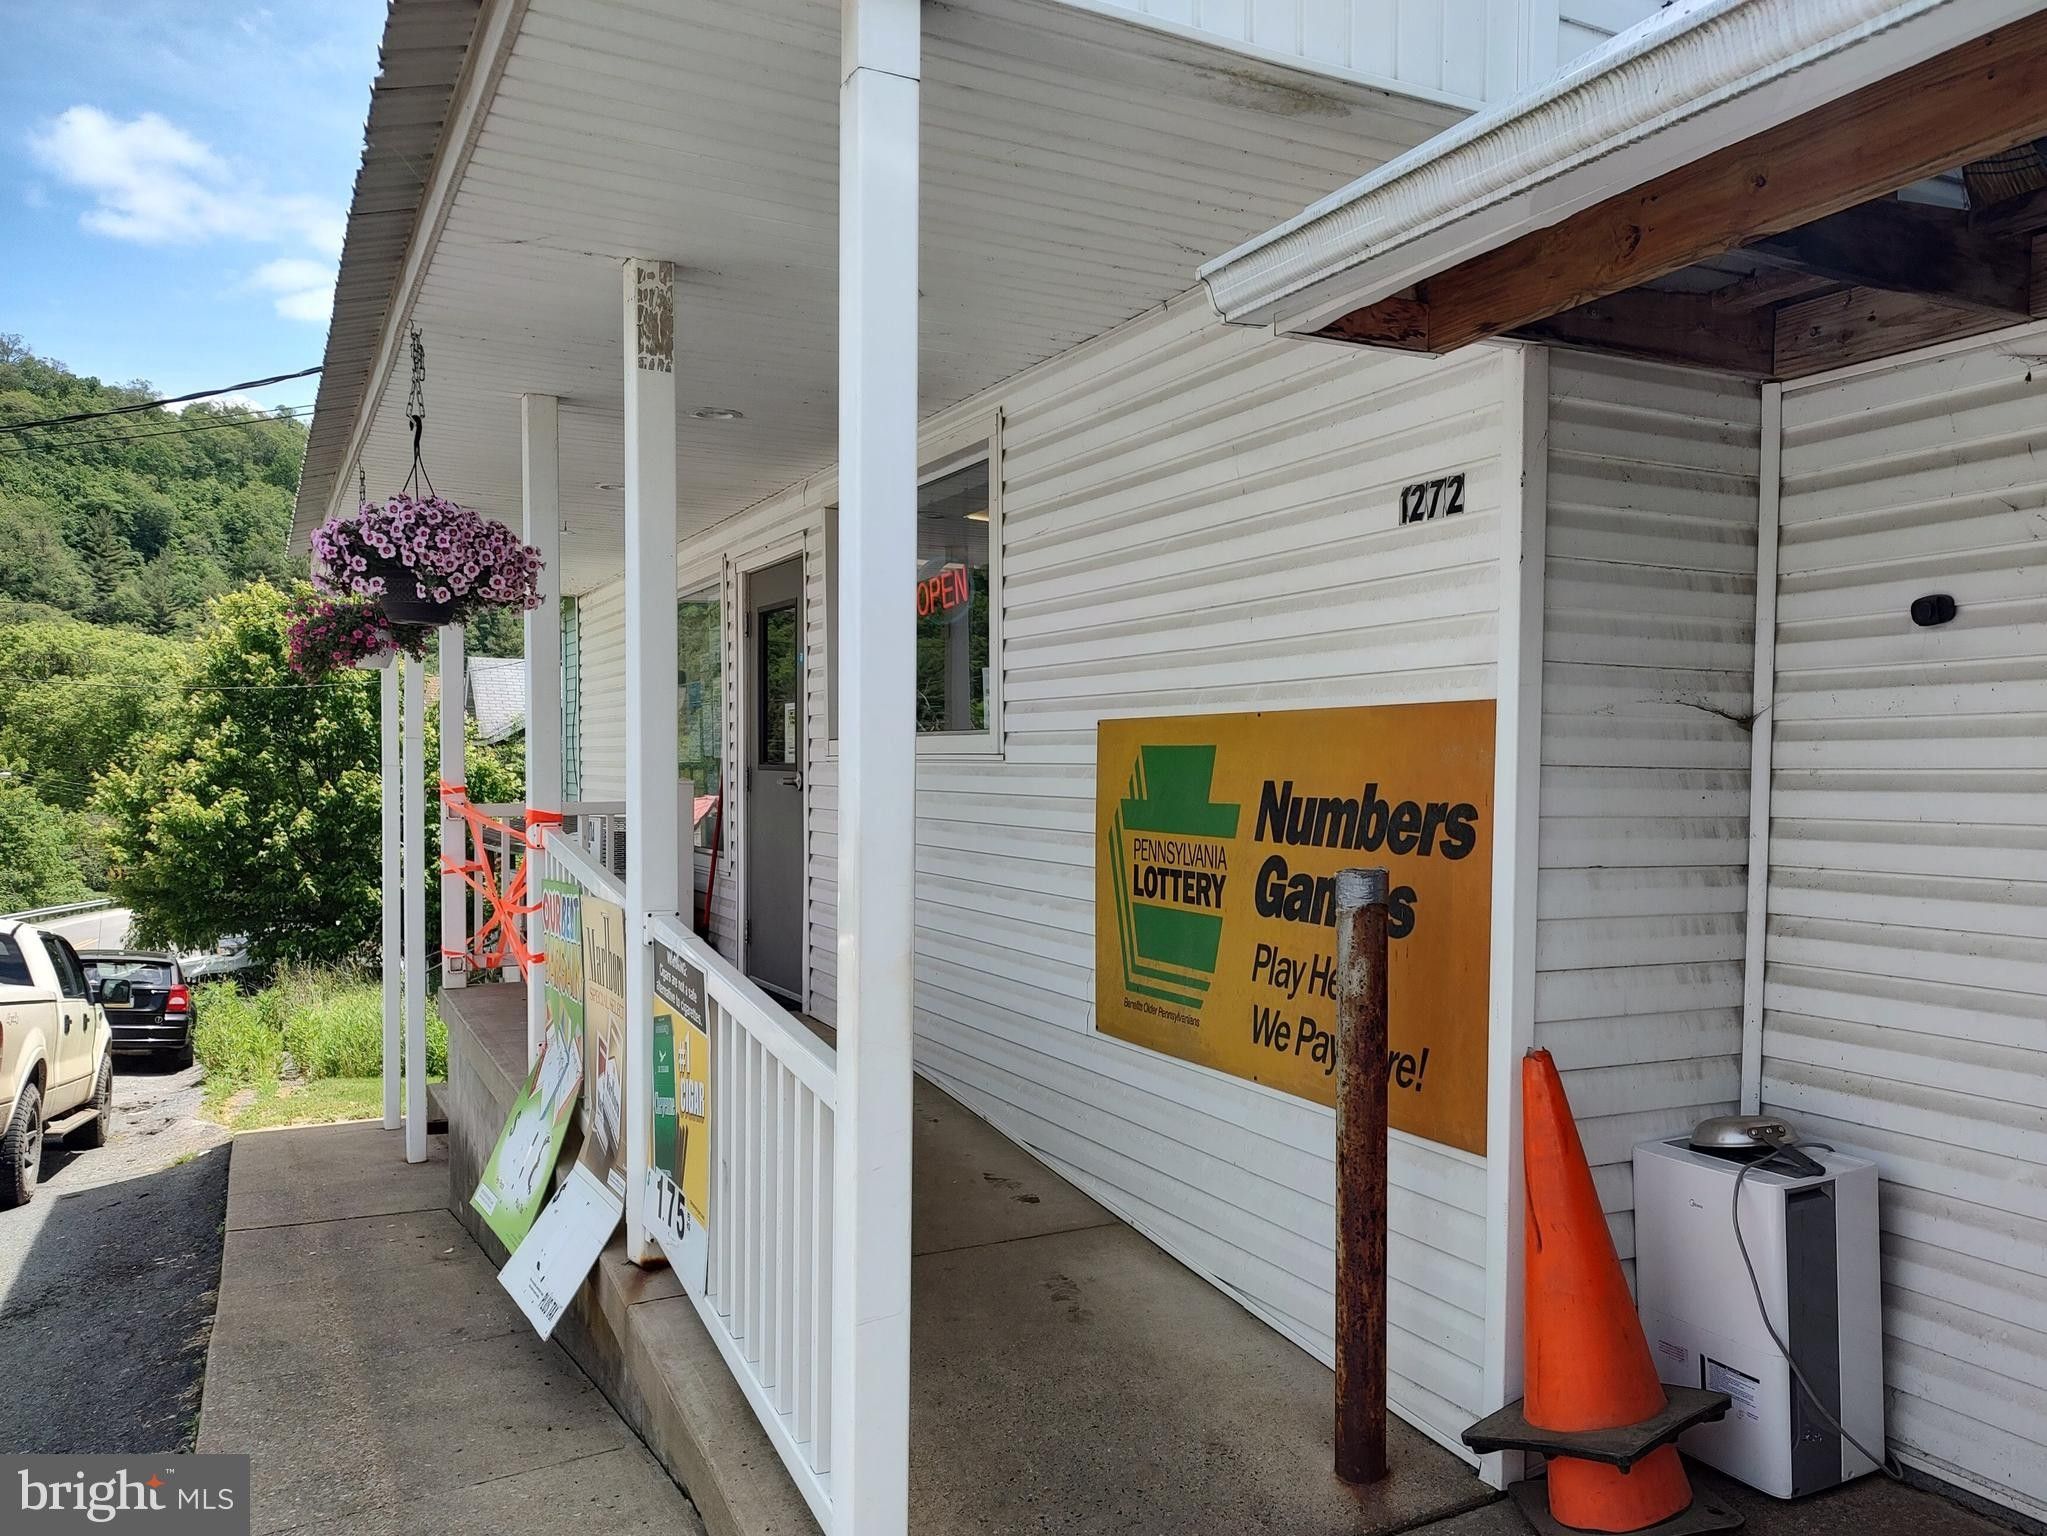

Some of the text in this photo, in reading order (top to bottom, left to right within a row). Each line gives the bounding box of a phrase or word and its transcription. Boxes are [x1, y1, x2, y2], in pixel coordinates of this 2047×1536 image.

[1399, 473, 1465, 525] 1272
[917, 565, 968, 616] OPEN
[1254, 780, 1479, 860] Numbers
[1134, 838, 1227, 871] PENNSYLVANIA
[1134, 864, 1227, 909] LOTTERY
[1255, 855, 1418, 939] Gams
[542, 890, 561, 937] OUR
[586, 911, 624, 999] Marlboro
[1252, 943, 1307, 1000] Play
[1124, 997, 1201, 1028] Benefits Older Pennsylvanians
[679, 1031, 690, 1073] #1
[1253, 1005, 1430, 1092] We Pay re!
[680, 1079, 705, 1118] CIGAR
[657, 1175, 686, 1241] 1.75
